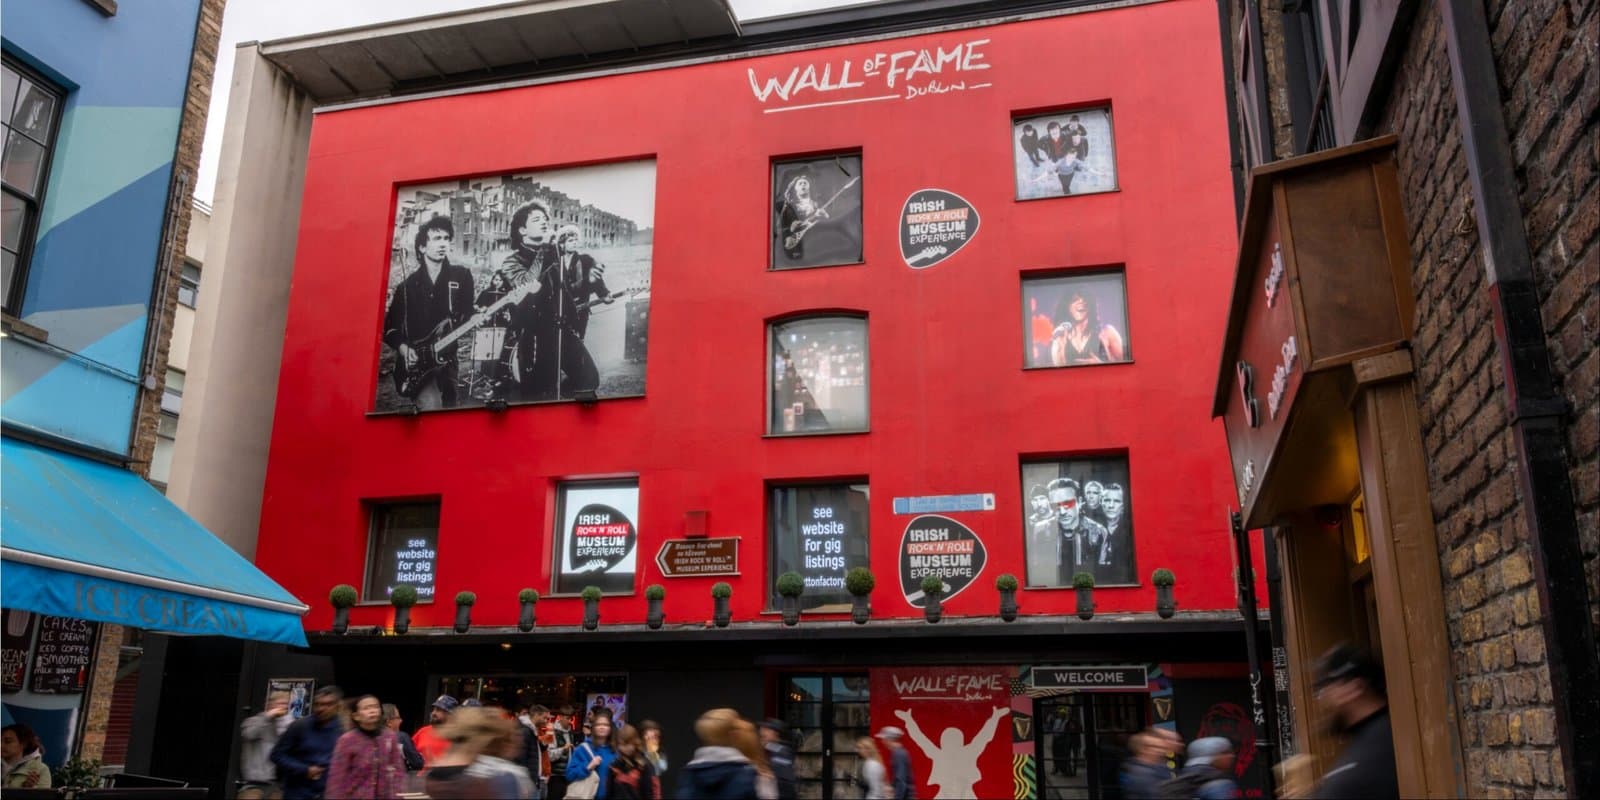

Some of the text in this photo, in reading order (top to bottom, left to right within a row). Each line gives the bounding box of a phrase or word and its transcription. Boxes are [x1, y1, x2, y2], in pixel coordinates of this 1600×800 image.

[747, 39, 991, 102] WALL OF FAME
[909, 200, 945, 213] IRISH
[909, 221, 966, 235] MUSEUM
[910, 232, 966, 244] EXPERIENCE
[812, 507, 833, 518] see
[578, 514, 610, 525] IRISH
[801, 521, 844, 535] website
[910, 528, 949, 541] IRISH
[408, 539, 426, 548] see
[577, 535, 625, 547] MUSEUM
[805, 538, 841, 553] for gig
[397, 549, 435, 559] website
[577, 546, 625, 557] EXPERIENCE
[398, 560, 431, 572] for gig
[805, 555, 845, 570] listings
[910, 553, 972, 567] MUSEUM
[701, 563, 733, 571] EXPERIENCE
[911, 566, 972, 579] EXPERIENCE
[397, 572, 433, 583] listings
[73, 581, 248, 633] ICE CREAM
[42, 615, 87, 632] CAKES
[40, 631, 86, 641] ICE CREAM
[892, 673, 947, 694] WALL
[957, 674, 1003, 694] FAME
[1055, 672, 1124, 683] WELCOME
